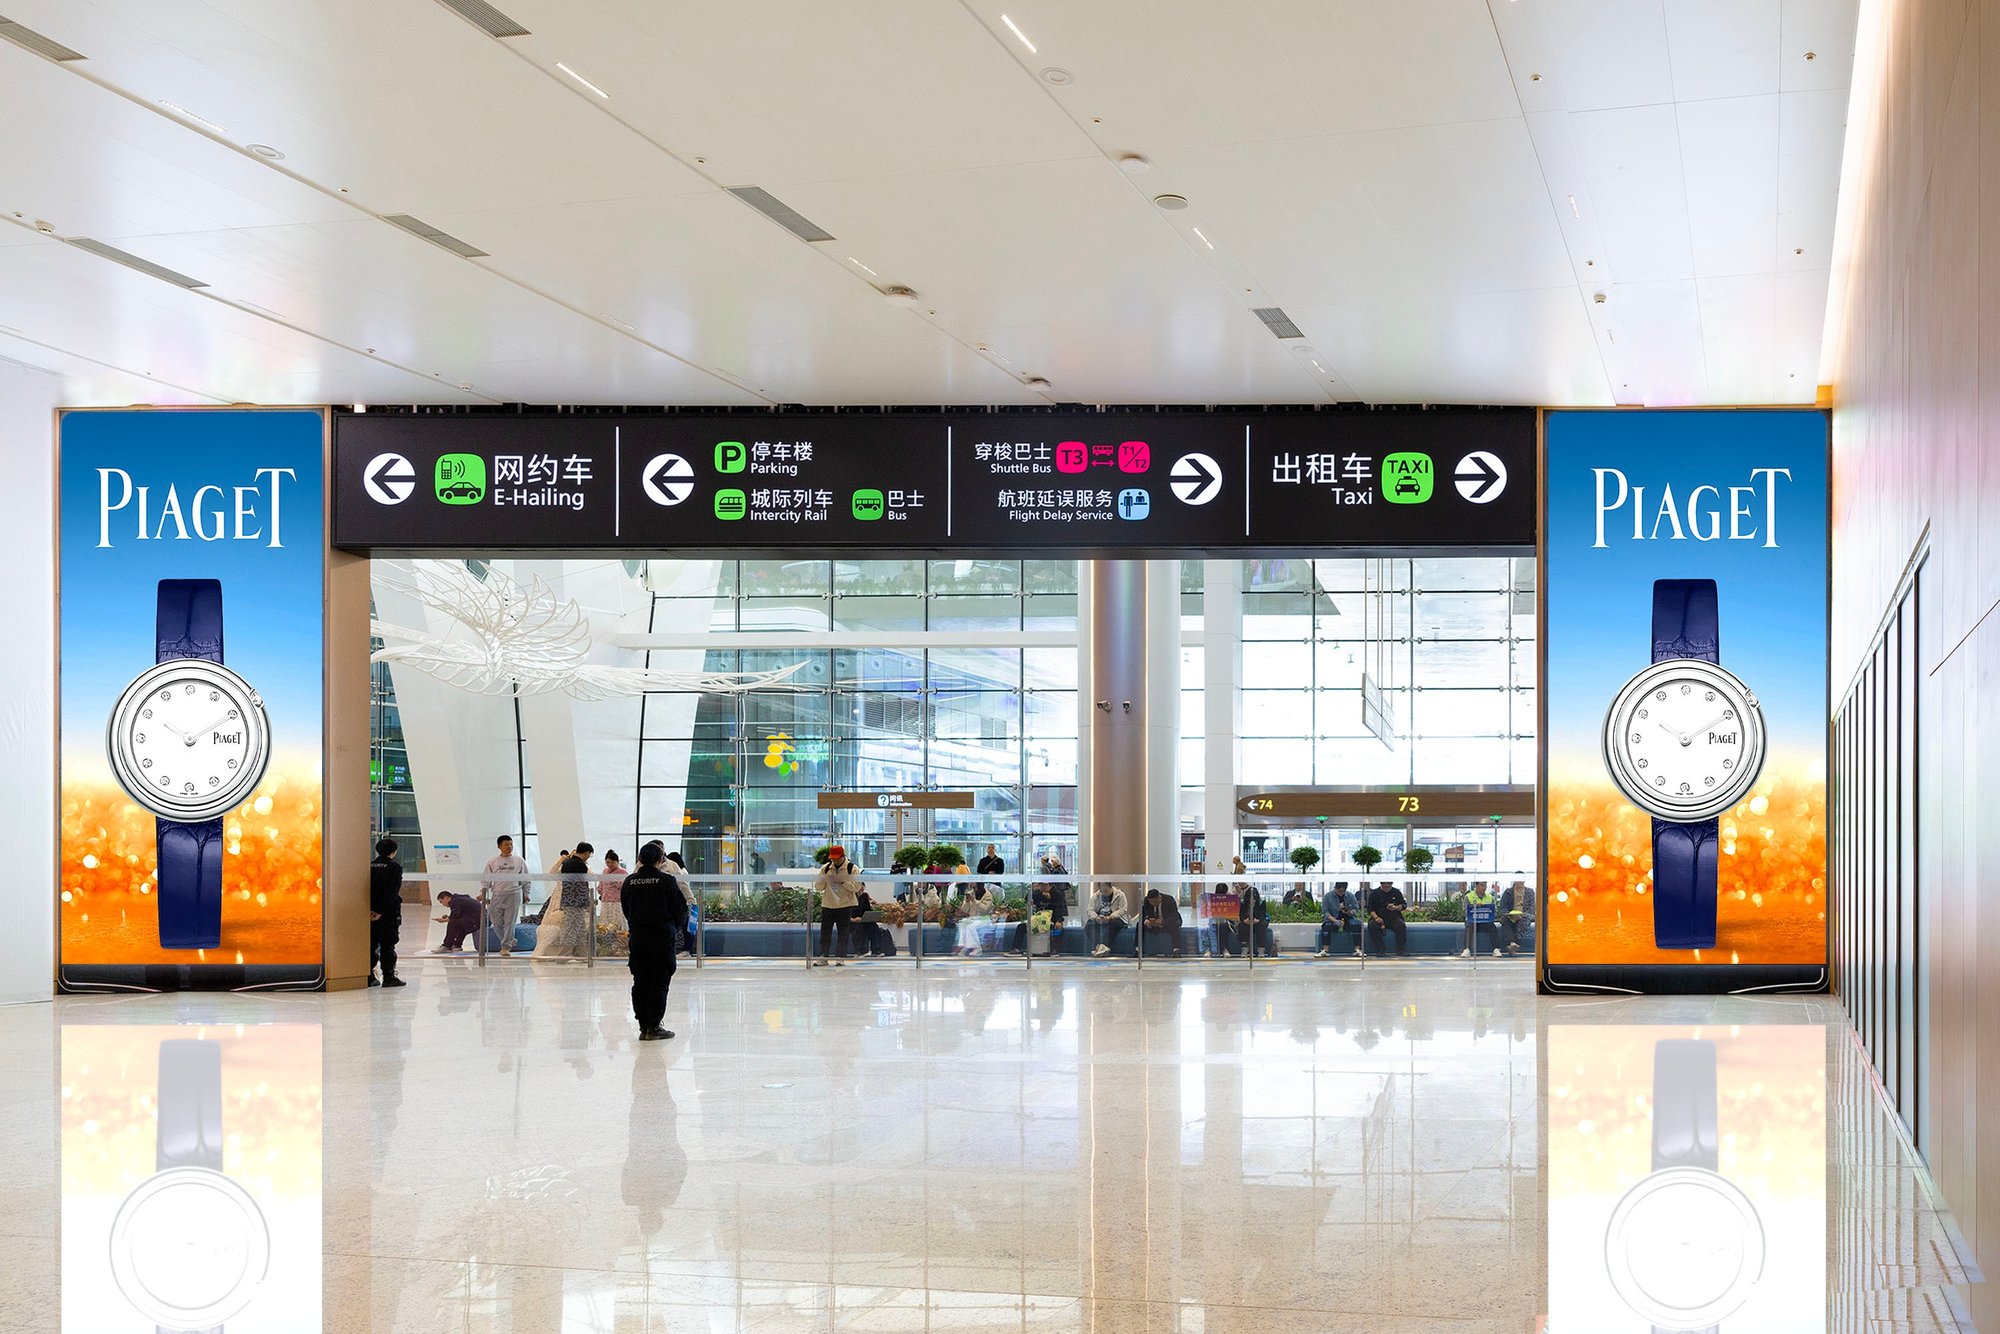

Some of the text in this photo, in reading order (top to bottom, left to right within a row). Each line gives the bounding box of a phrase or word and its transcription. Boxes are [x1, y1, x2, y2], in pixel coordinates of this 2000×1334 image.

[750, 441, 813, 461] 停车楼
[974, 441, 1052, 461] 穿梭巴士
[1061, 449, 1083, 465] T3
[494, 453, 593, 486] 网约车
[750, 462, 798, 477] Parking
[990, 462, 1052, 474] Shuttle Bus
[1272, 452, 1373, 485] 出租车
[1387, 460, 1429, 473] TAXI
[494, 486, 585, 511] E-Hailing
[750, 488, 834, 509] 城际列车
[888, 489, 925, 508] 巴士
[997, 489, 1113, 508] 航班延误服务
[1331, 486, 1373, 505] Taxi
[96, 468, 296, 548] PIAGET
[888, 510, 907, 521] Bus
[1009, 509, 1114, 523] Flight Delay Service
[1592, 468, 1792, 548] PIAGET
[750, 509, 827, 524] Intercity Rail
[213, 732, 242, 745] PIAGET
[1708, 732, 1737, 745] PIAGET
[1258, 799, 1274, 810] 74
[1398, 796, 1420, 812] 73
[630, 877, 660, 886] SECURITY
